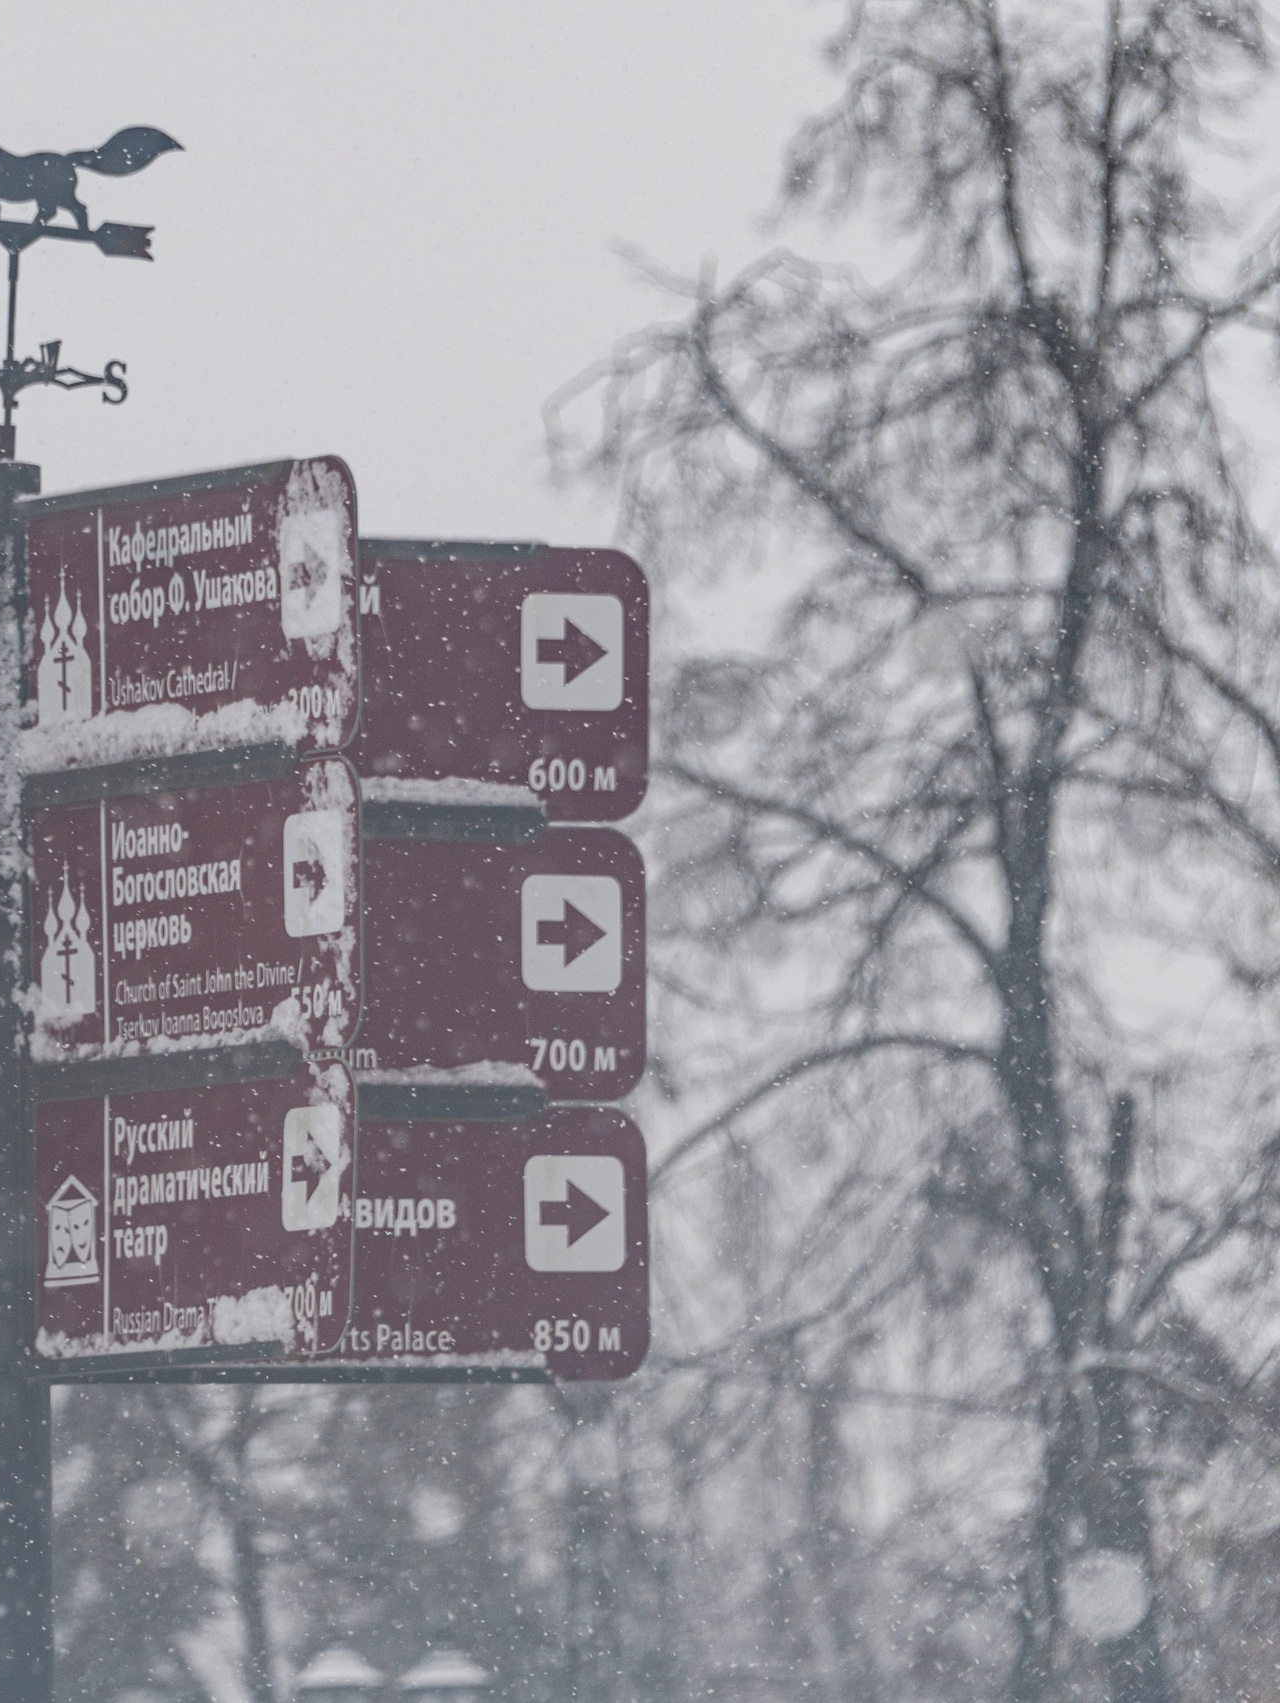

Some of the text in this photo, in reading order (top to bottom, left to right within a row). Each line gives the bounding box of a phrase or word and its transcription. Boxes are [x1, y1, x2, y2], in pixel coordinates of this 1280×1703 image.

[109, 499, 253, 573] Кафедральный
[109, 566, 277, 629] собор Ф. Ушакова
[110, 671, 166, 707] Ushakov
[166, 660, 230, 698] Cathedral
[528, 757, 617, 792] 600 м
[111, 821, 190, 861] Иоанно-
[112, 858, 242, 907] Богословская
[113, 912, 193, 960] церковь
[115, 979, 157, 1006] Church
[158, 975, 173, 1001] of
[172, 970, 203, 998] Saint
[204, 965, 233, 995] John
[234, 963, 255, 990] the
[256, 959, 296, 988] Divine
[202, 1000, 264, 1034] Bogoslova
[531, 1037, 617, 1073] 700 м
[113, 1108, 195, 1165] Русский
[112, 1150, 269, 1217] драматический
[354, 1197, 458, 1237] видов
[113, 1224, 169, 1266] театр
[113, 1305, 160, 1335] Russian
[163, 1300, 205, 1332] Drama
[377, 1322, 454, 1352] Palace
[534, 1318, 622, 1353] 850 м
